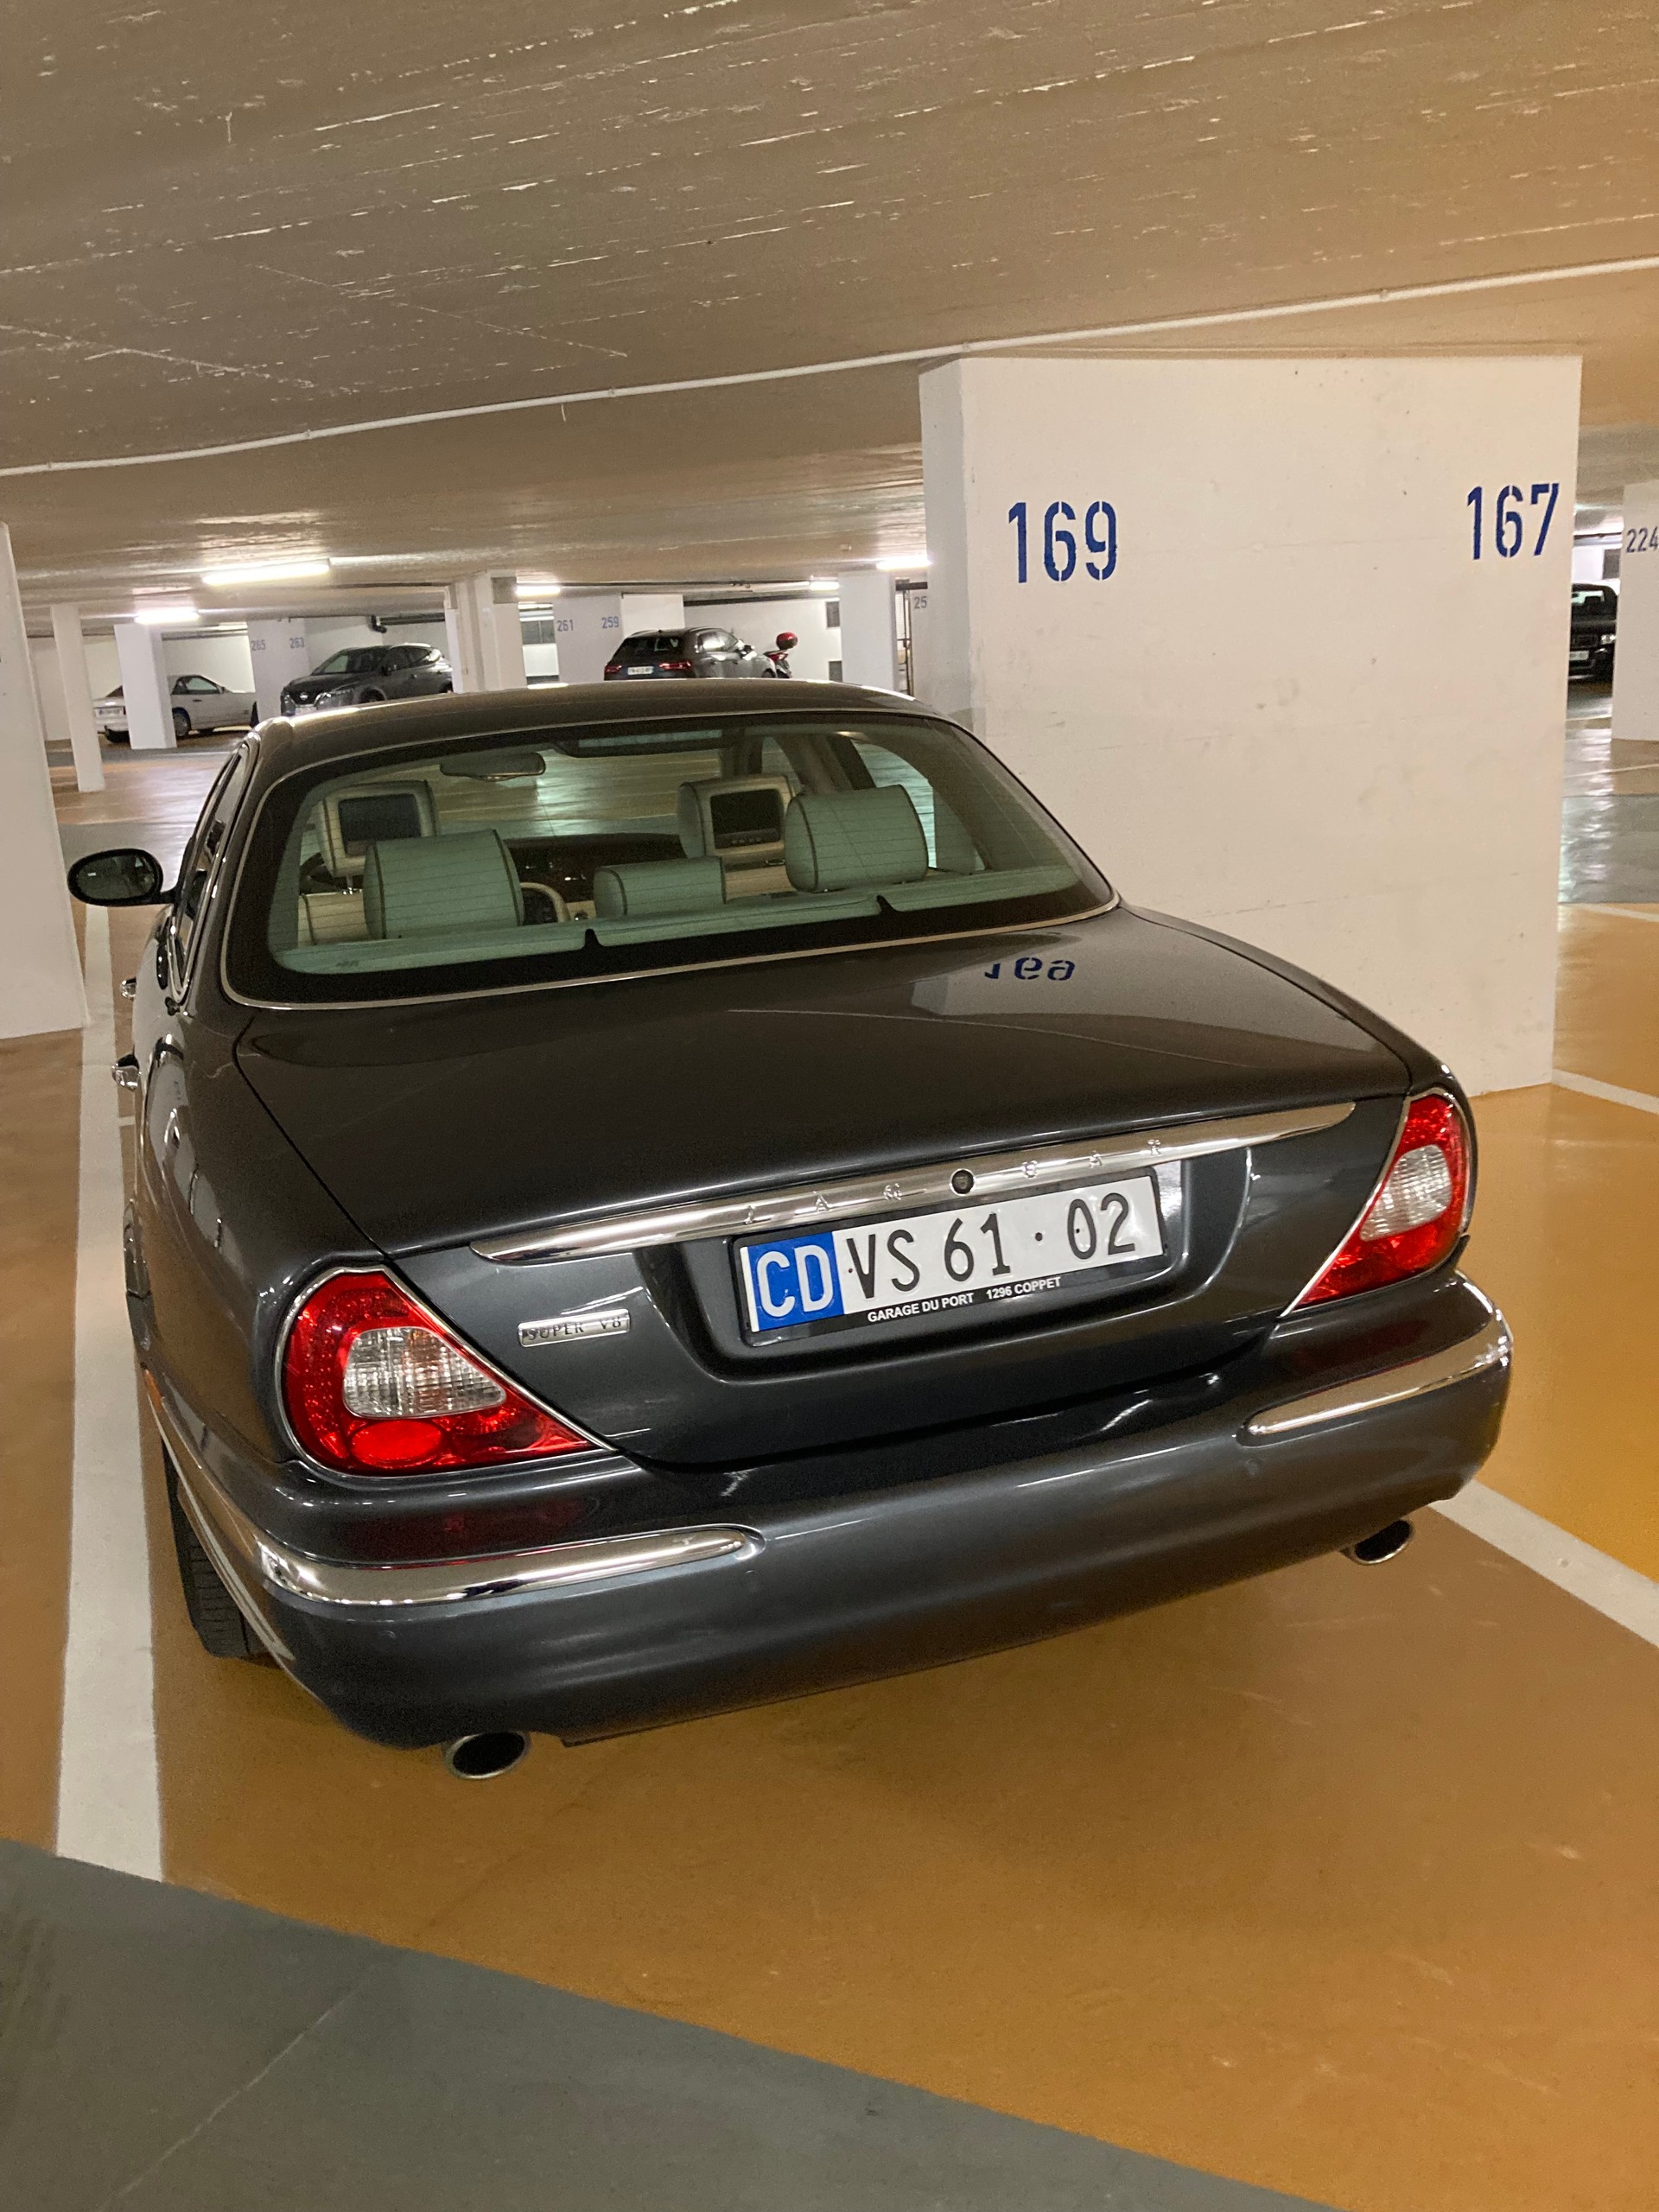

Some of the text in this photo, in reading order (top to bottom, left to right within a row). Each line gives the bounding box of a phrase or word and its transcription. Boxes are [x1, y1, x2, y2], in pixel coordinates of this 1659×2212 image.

[1467, 482, 1560, 561] 167
[1007, 499, 1118, 584] 169
[1625, 525, 1659, 554] 224
[913, 595, 928, 610] 25
[556, 620, 574, 632] 261
[601, 616, 620, 630] 259
[756, 1243, 836, 1319] CD
[846, 1228, 920, 1300] VS
[1066, 1192, 1136, 1261] 02
[867, 1276, 1062, 1323] GARAGE DU PORT 1296 COPPET
[526, 1316, 621, 1341] SUPER V8
